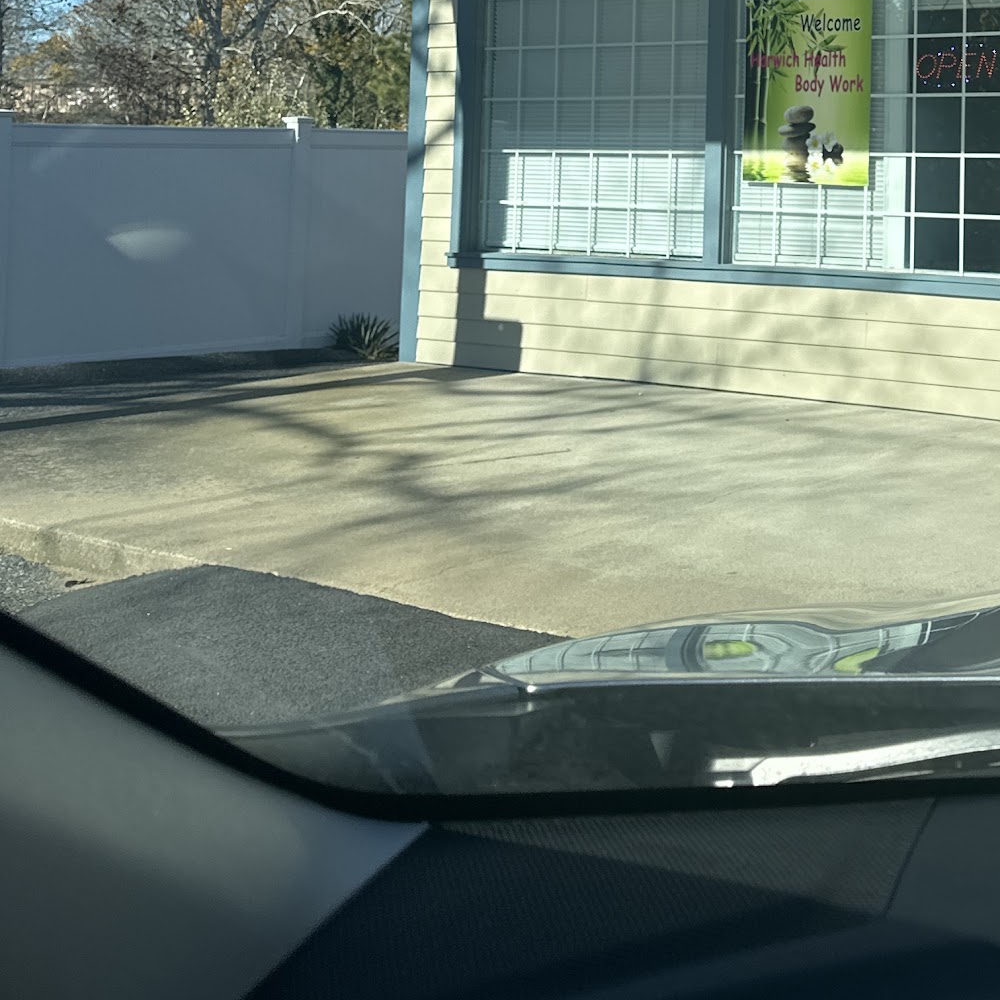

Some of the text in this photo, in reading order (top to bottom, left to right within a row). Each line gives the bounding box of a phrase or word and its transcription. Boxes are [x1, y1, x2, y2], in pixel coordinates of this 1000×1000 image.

[800, 13, 862, 32] Welcome
[751, 49, 846, 68] Harwich Health
[916, 52, 997, 79] OPEN
[795, 74, 864, 98] Body Work
